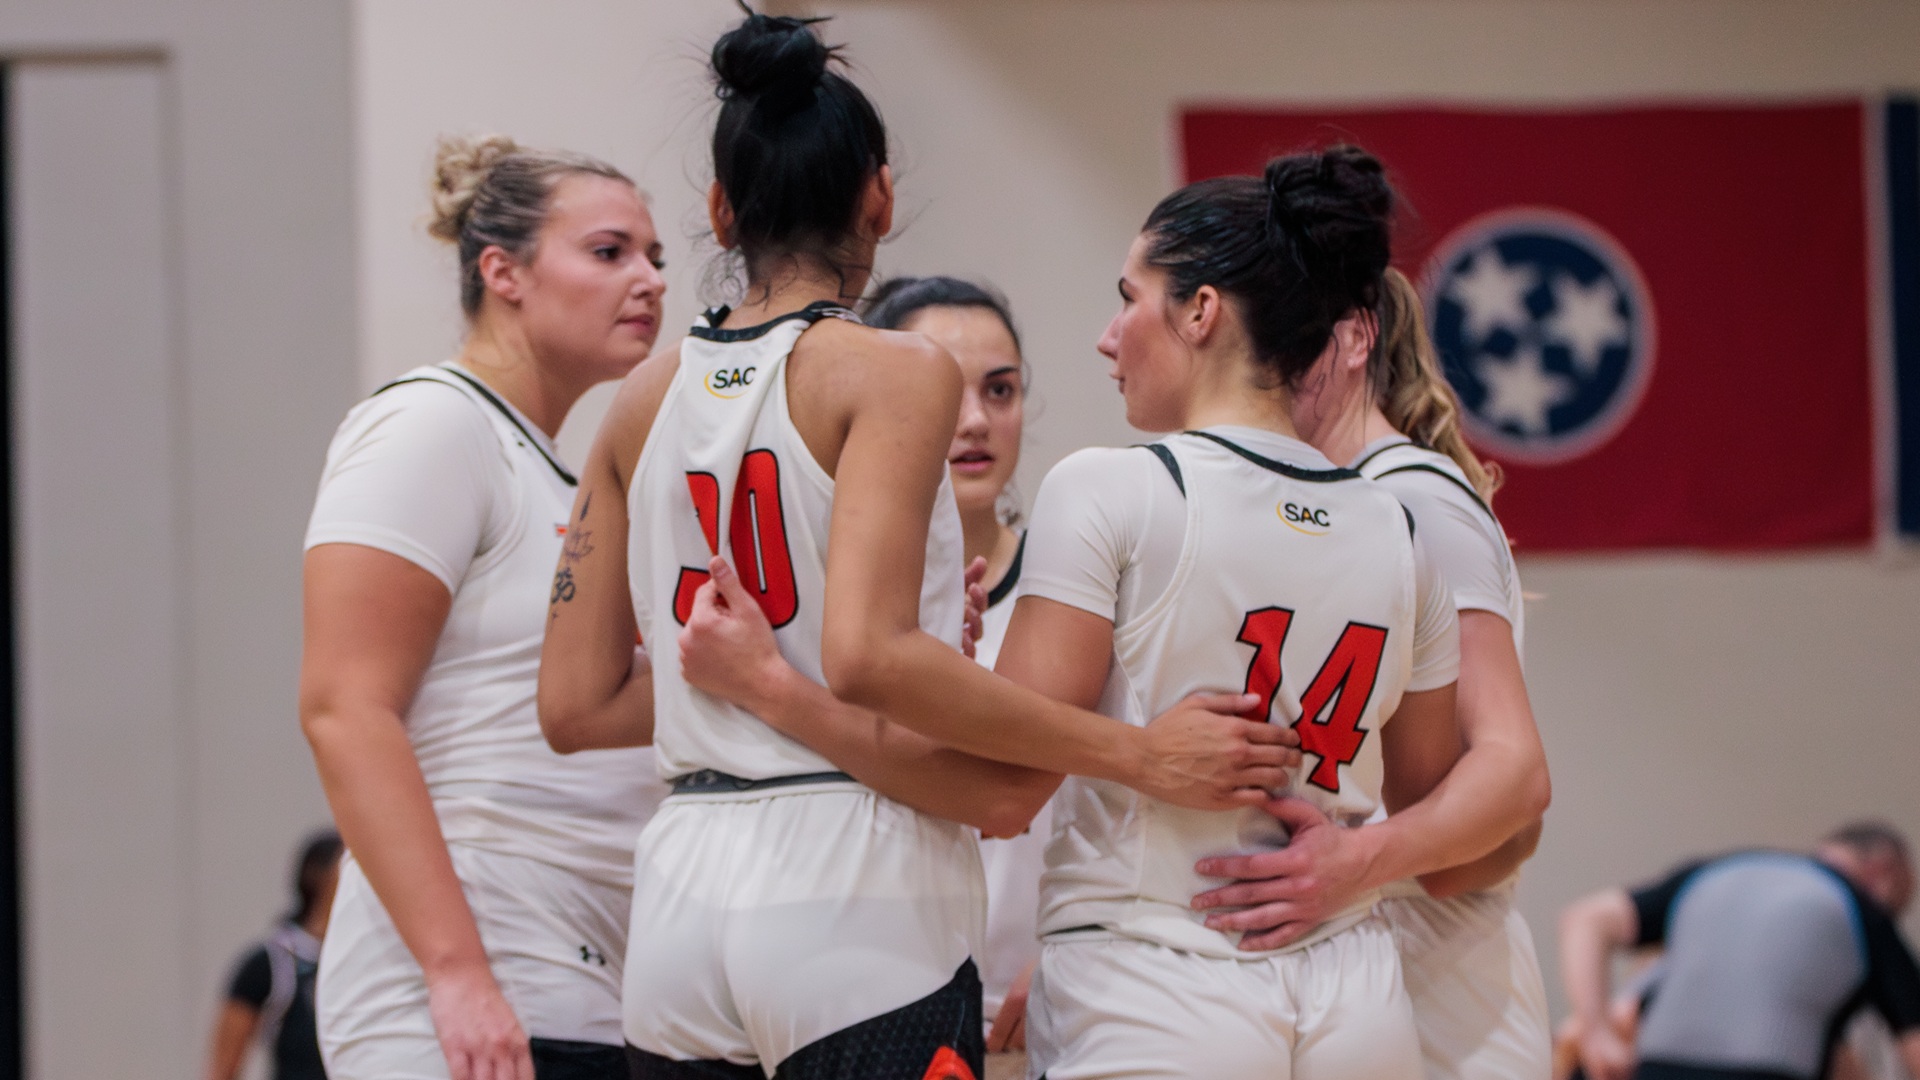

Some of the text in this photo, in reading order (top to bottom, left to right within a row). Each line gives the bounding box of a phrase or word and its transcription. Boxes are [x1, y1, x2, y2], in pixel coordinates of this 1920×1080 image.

[712, 366, 757, 390] SAC
[1284, 502, 1331, 528] SAC
[1236, 605, 1390, 794] 14
